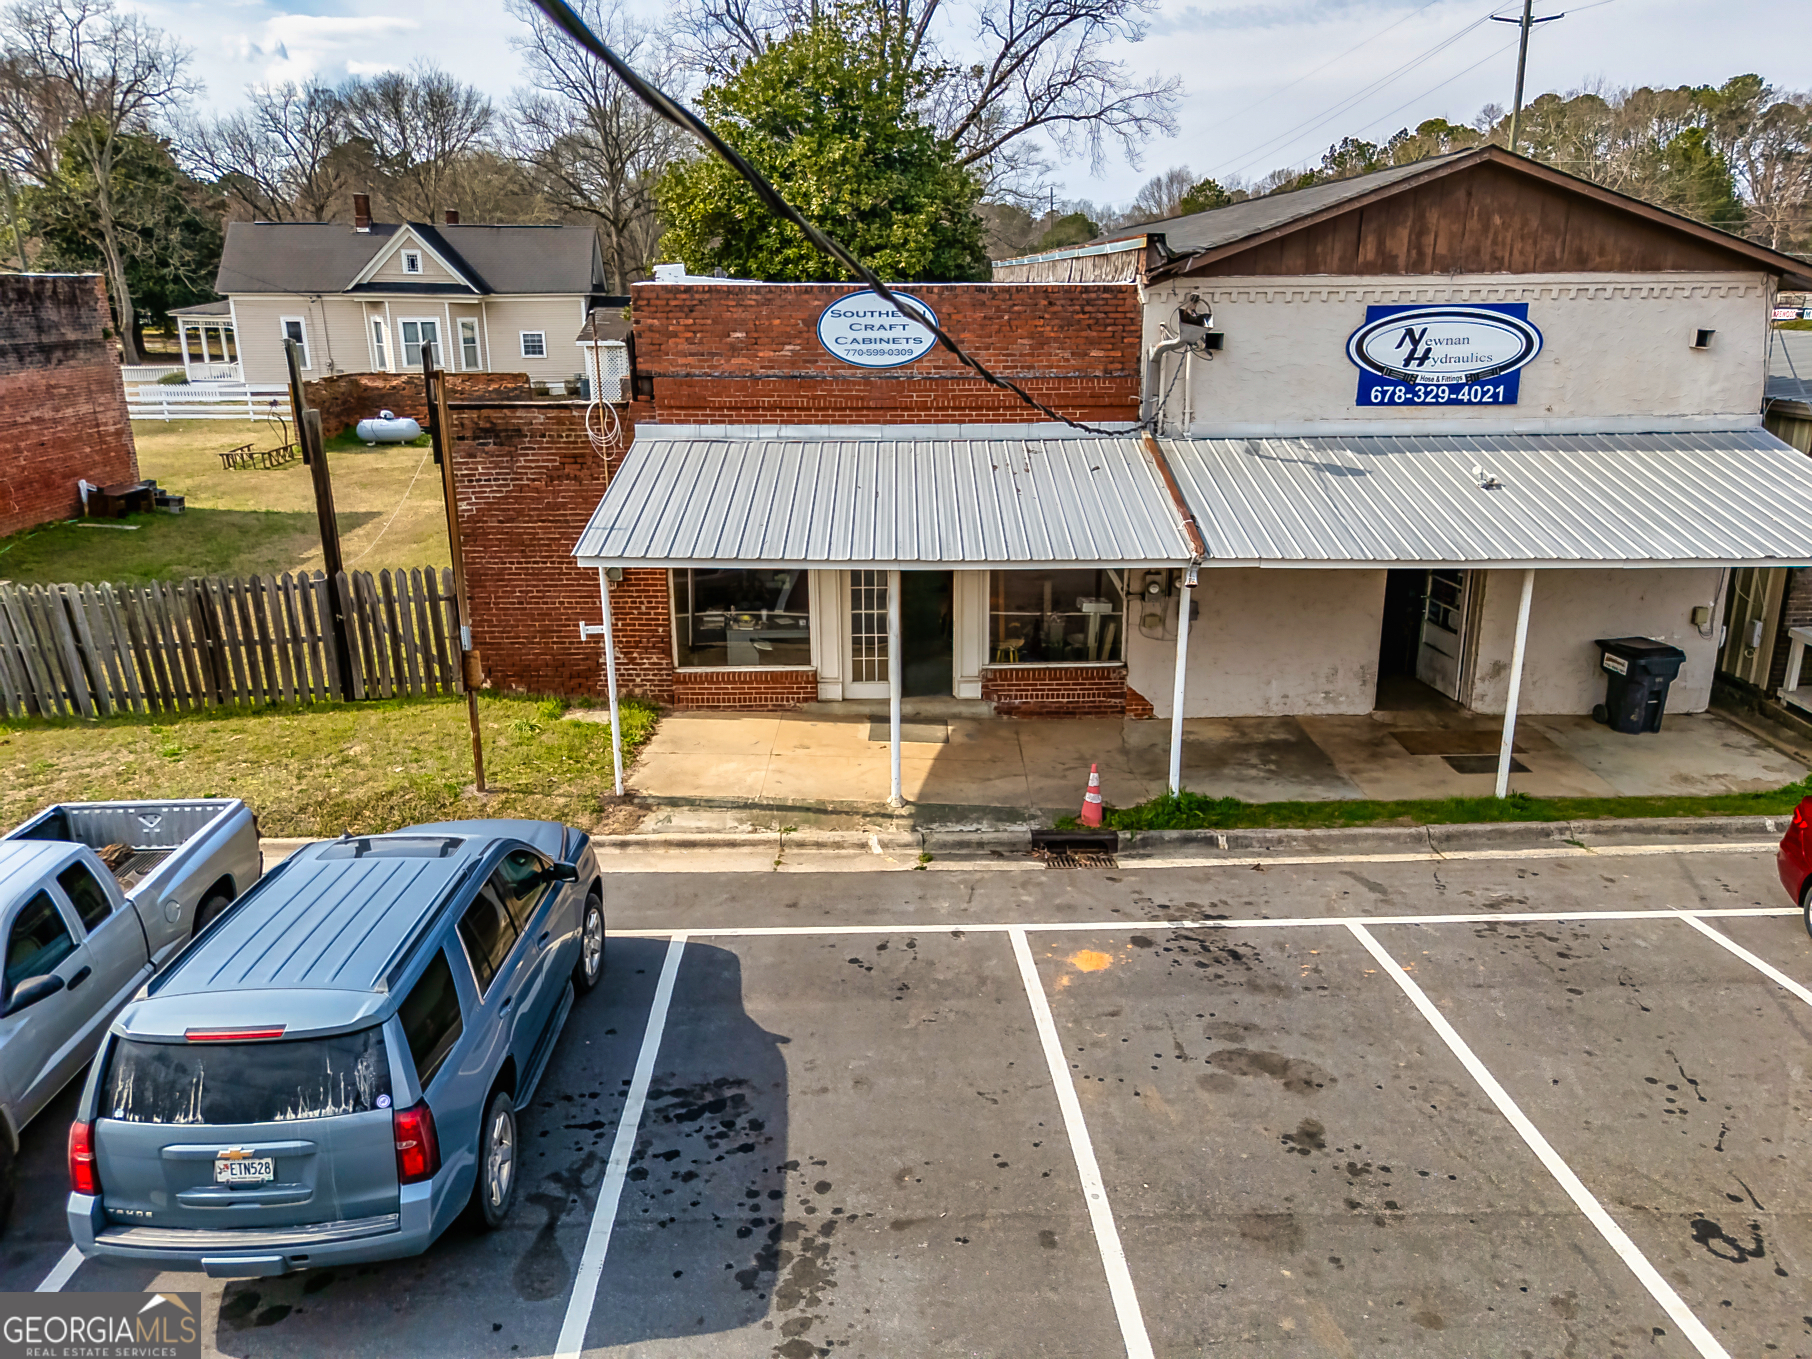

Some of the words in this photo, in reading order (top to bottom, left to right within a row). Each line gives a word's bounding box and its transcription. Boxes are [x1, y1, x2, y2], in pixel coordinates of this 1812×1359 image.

[849, 323, 909, 332] CRAFT
[835, 337, 923, 345] CABINETS
[1395, 327, 1470, 350] Newnan
[1402, 347, 1493, 368] Hydraulics
[1442, 375, 1463, 383] Fittings
[1370, 385, 1505, 403] 678-329-4021
[230, 1162, 271, 1175] ETN528
